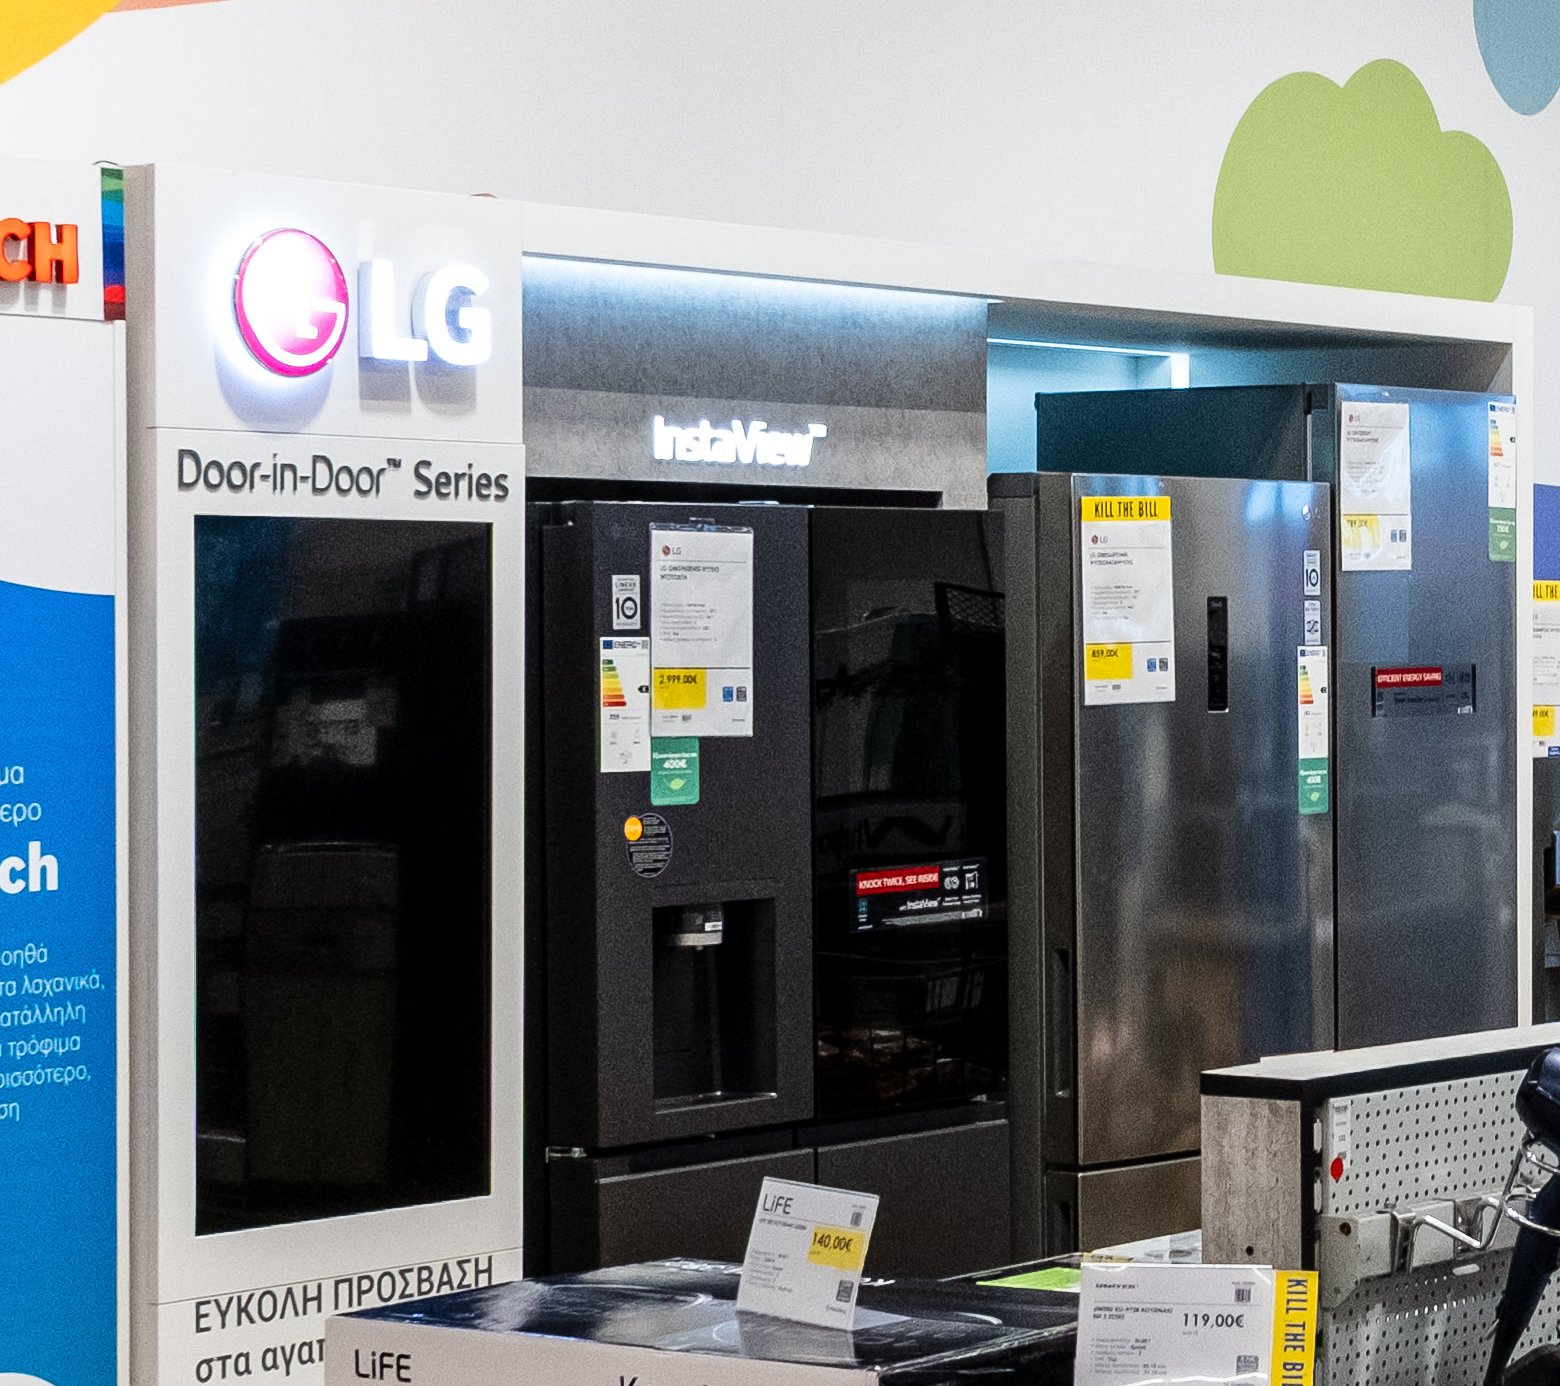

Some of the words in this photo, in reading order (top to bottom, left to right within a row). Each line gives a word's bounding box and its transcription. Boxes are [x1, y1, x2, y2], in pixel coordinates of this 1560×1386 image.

[359, 259, 492, 367] LG
[413, 460, 510, 502] Series
[1093, 500, 1114, 518] KILL
[1117, 500, 1135, 518] THE
[1138, 500, 1159, 518] BILL
[1544, 585, 1559, 600] THE
[21, 968, 105, 998] λαχανικά,
[7, 1034, 82, 1061] τρόφιμα
[762, 1192, 795, 1215] LiFE
[194, 1281, 324, 1334] ΕΥΚΟΛΗ
[333, 1255, 493, 1312] ΠΡΟΣΒΑΣΗ
[1286, 1278, 1309, 1315] KILL
[1182, 1312, 1245, 1329] 119,00€
[1283, 1321, 1307, 1353] THE
[194, 1348, 253, 1384] στα
[353, 1347, 413, 1384] LiFE
